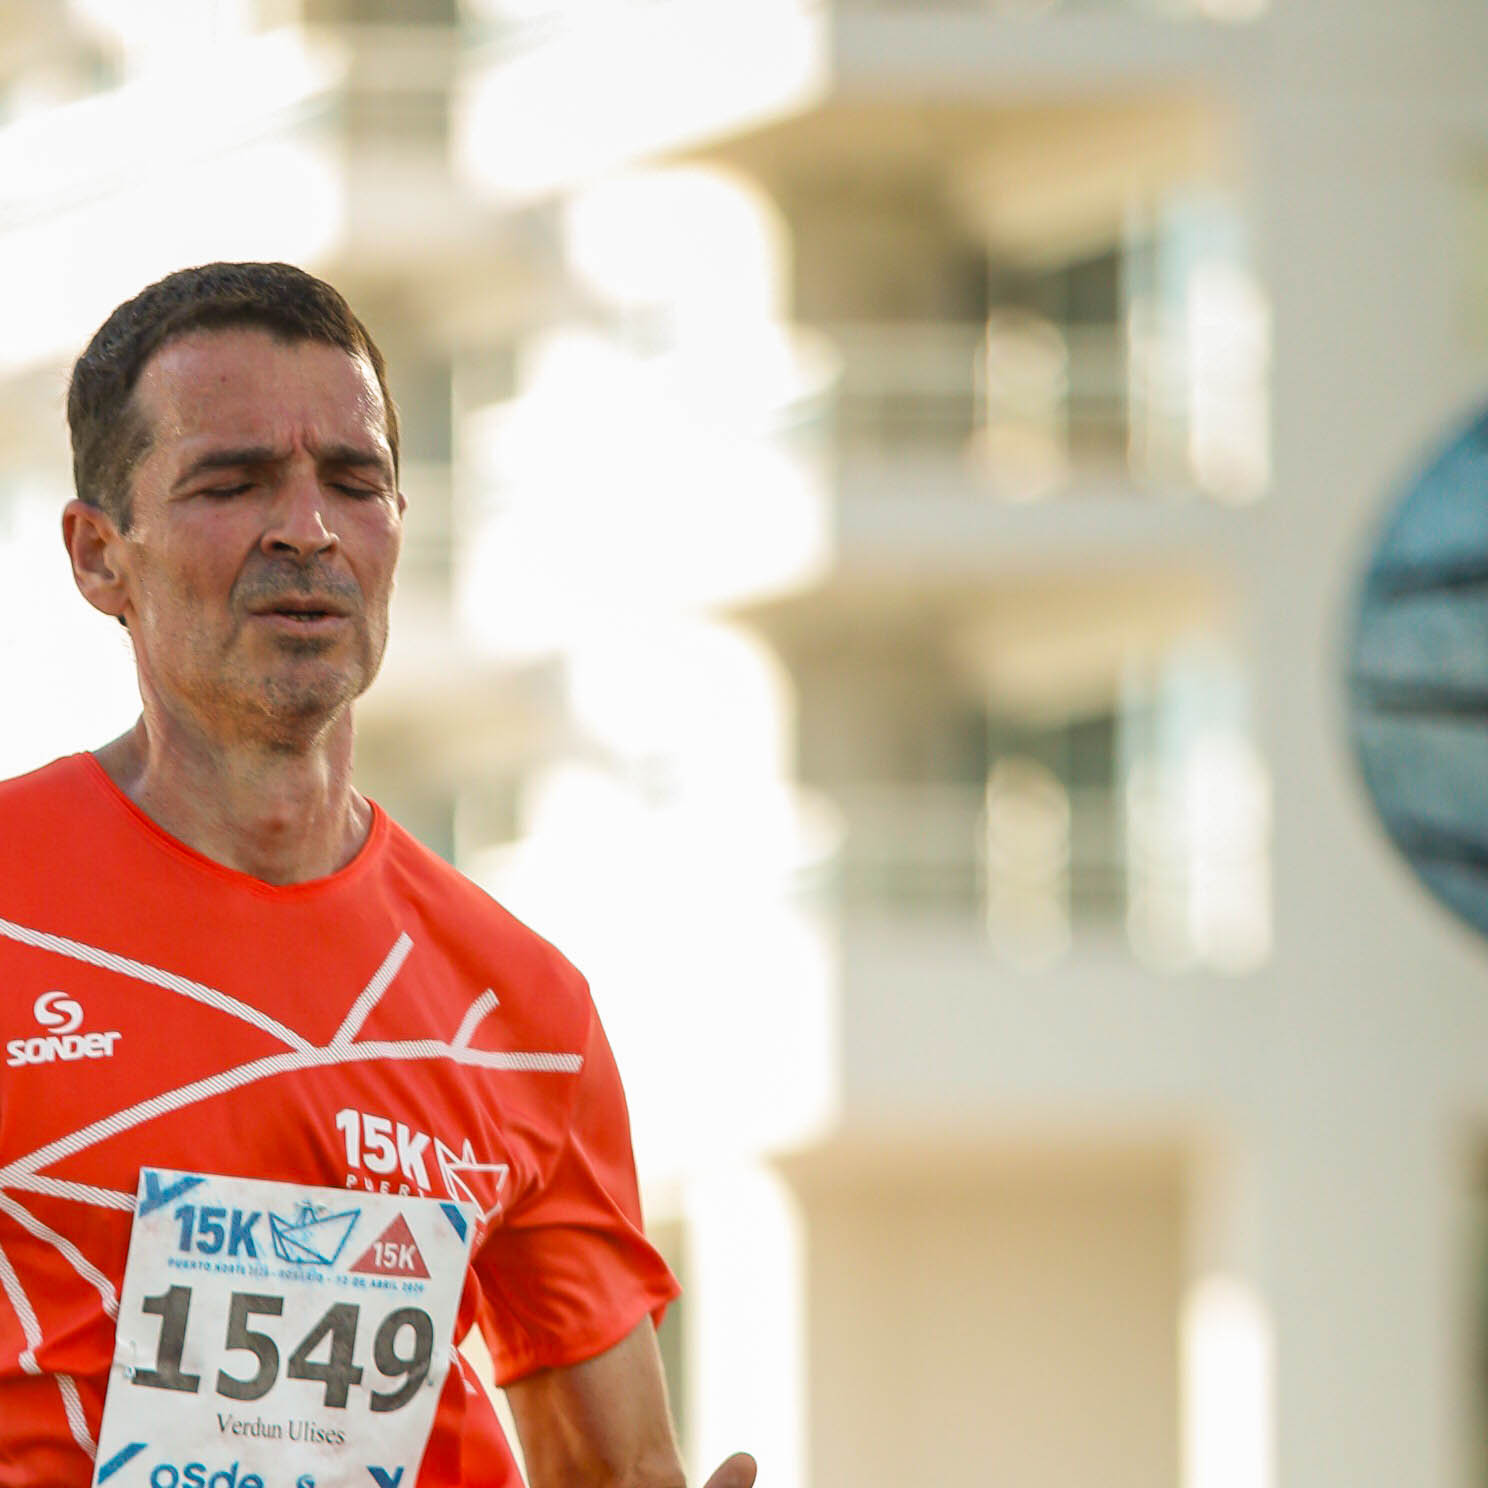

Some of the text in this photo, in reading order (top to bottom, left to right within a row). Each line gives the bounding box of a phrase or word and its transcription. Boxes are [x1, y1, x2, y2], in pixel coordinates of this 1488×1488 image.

[335, 1108, 432, 1192] 15K
[173, 1204, 262, 1258] 15K
[373, 1241, 417, 1271] 15K
[132, 1285, 434, 1412] 1549
[217, 1413, 345, 1445] Verdun Ulises
